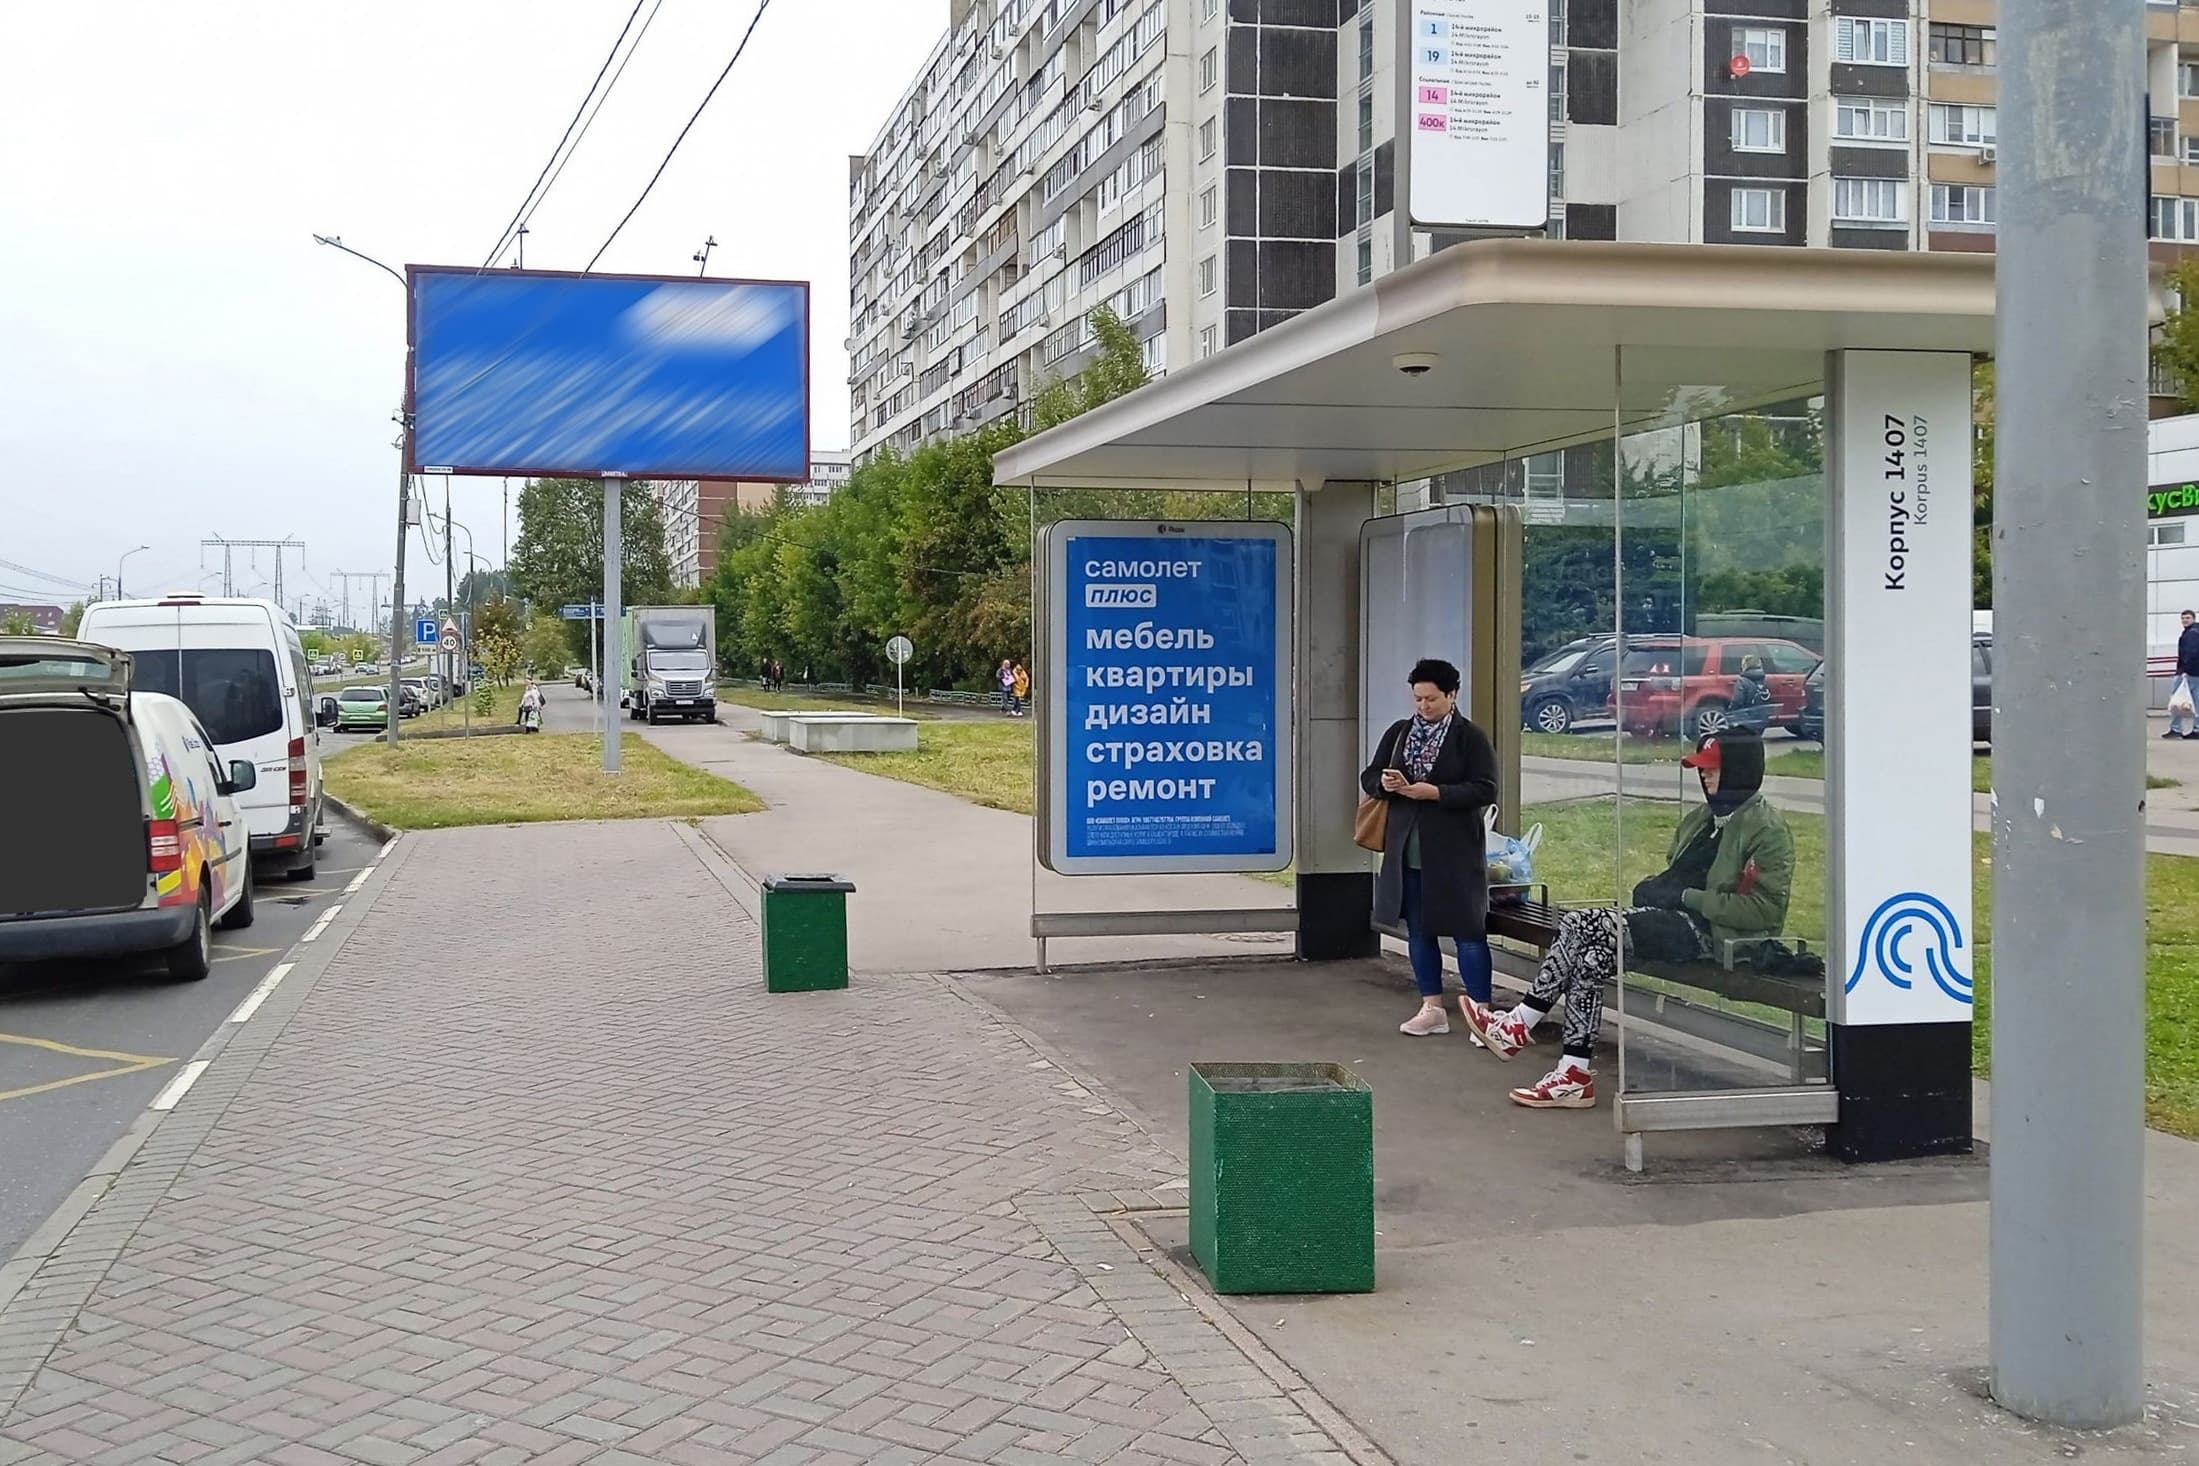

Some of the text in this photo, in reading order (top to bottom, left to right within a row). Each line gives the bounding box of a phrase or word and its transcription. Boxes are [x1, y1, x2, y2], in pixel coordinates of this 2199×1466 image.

[1431, 23, 1437, 34] 1
[1428, 50, 1439, 62] 19
[1427, 90, 1439, 100] 14
[1913, 415, 1931, 525] Korpus 1407
[1885, 414, 1909, 589] Корпус 1407
[1085, 560, 1202, 578] самолет
[1090, 589, 1153, 604] плюс
[423, 622, 436, 640] P
[1086, 621, 1215, 650] мебель
[443, 639, 456, 647] 40
[1086, 666, 1254, 694] квартиры
[1084, 697, 1211, 730] дизайн
[1086, 741, 1263, 770] страховка
[1087, 778, 1217, 808] ремонт
